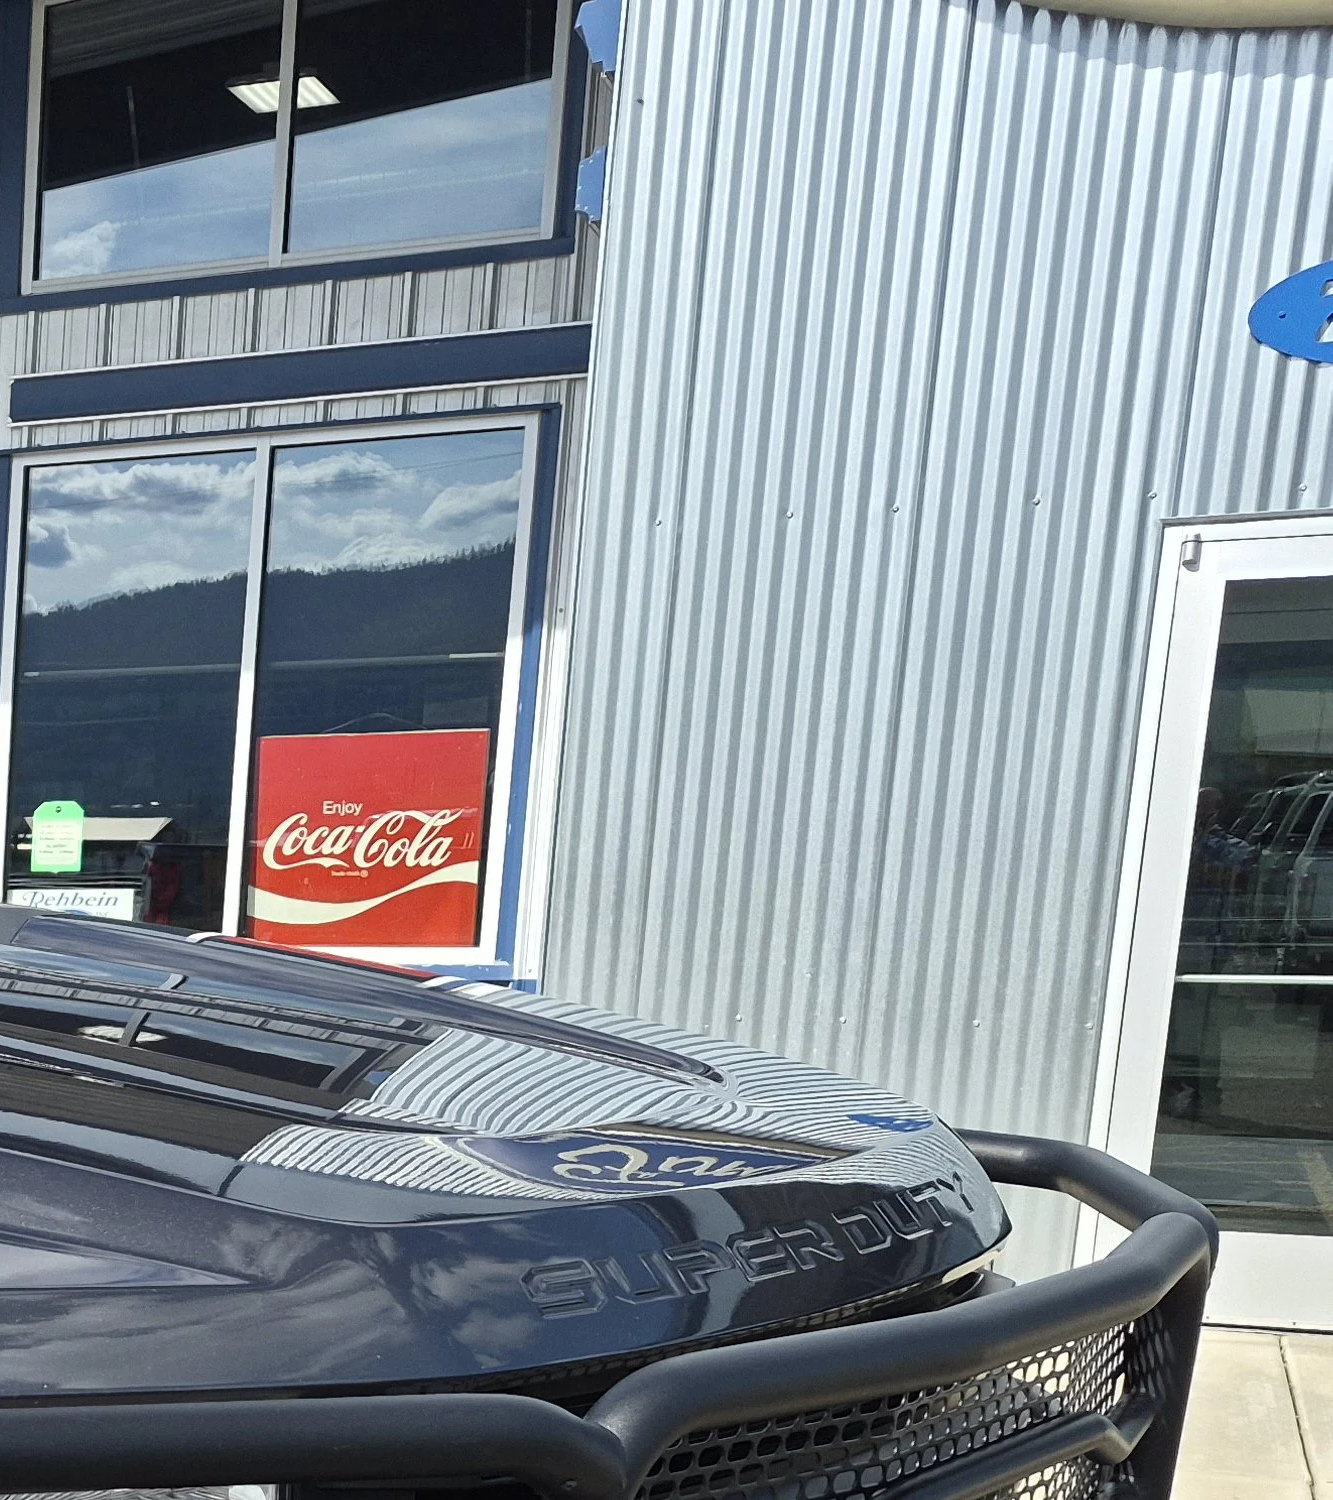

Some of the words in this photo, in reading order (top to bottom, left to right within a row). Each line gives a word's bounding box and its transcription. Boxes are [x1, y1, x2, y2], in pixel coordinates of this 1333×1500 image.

[322, 800, 363, 817] Enjoy
[262, 808, 465, 870] Coca-Cola
[22, 890, 119, 909] Rehbein
[520, 1218, 845, 1319] SUPER
[834, 1173, 977, 1257] DUTY
